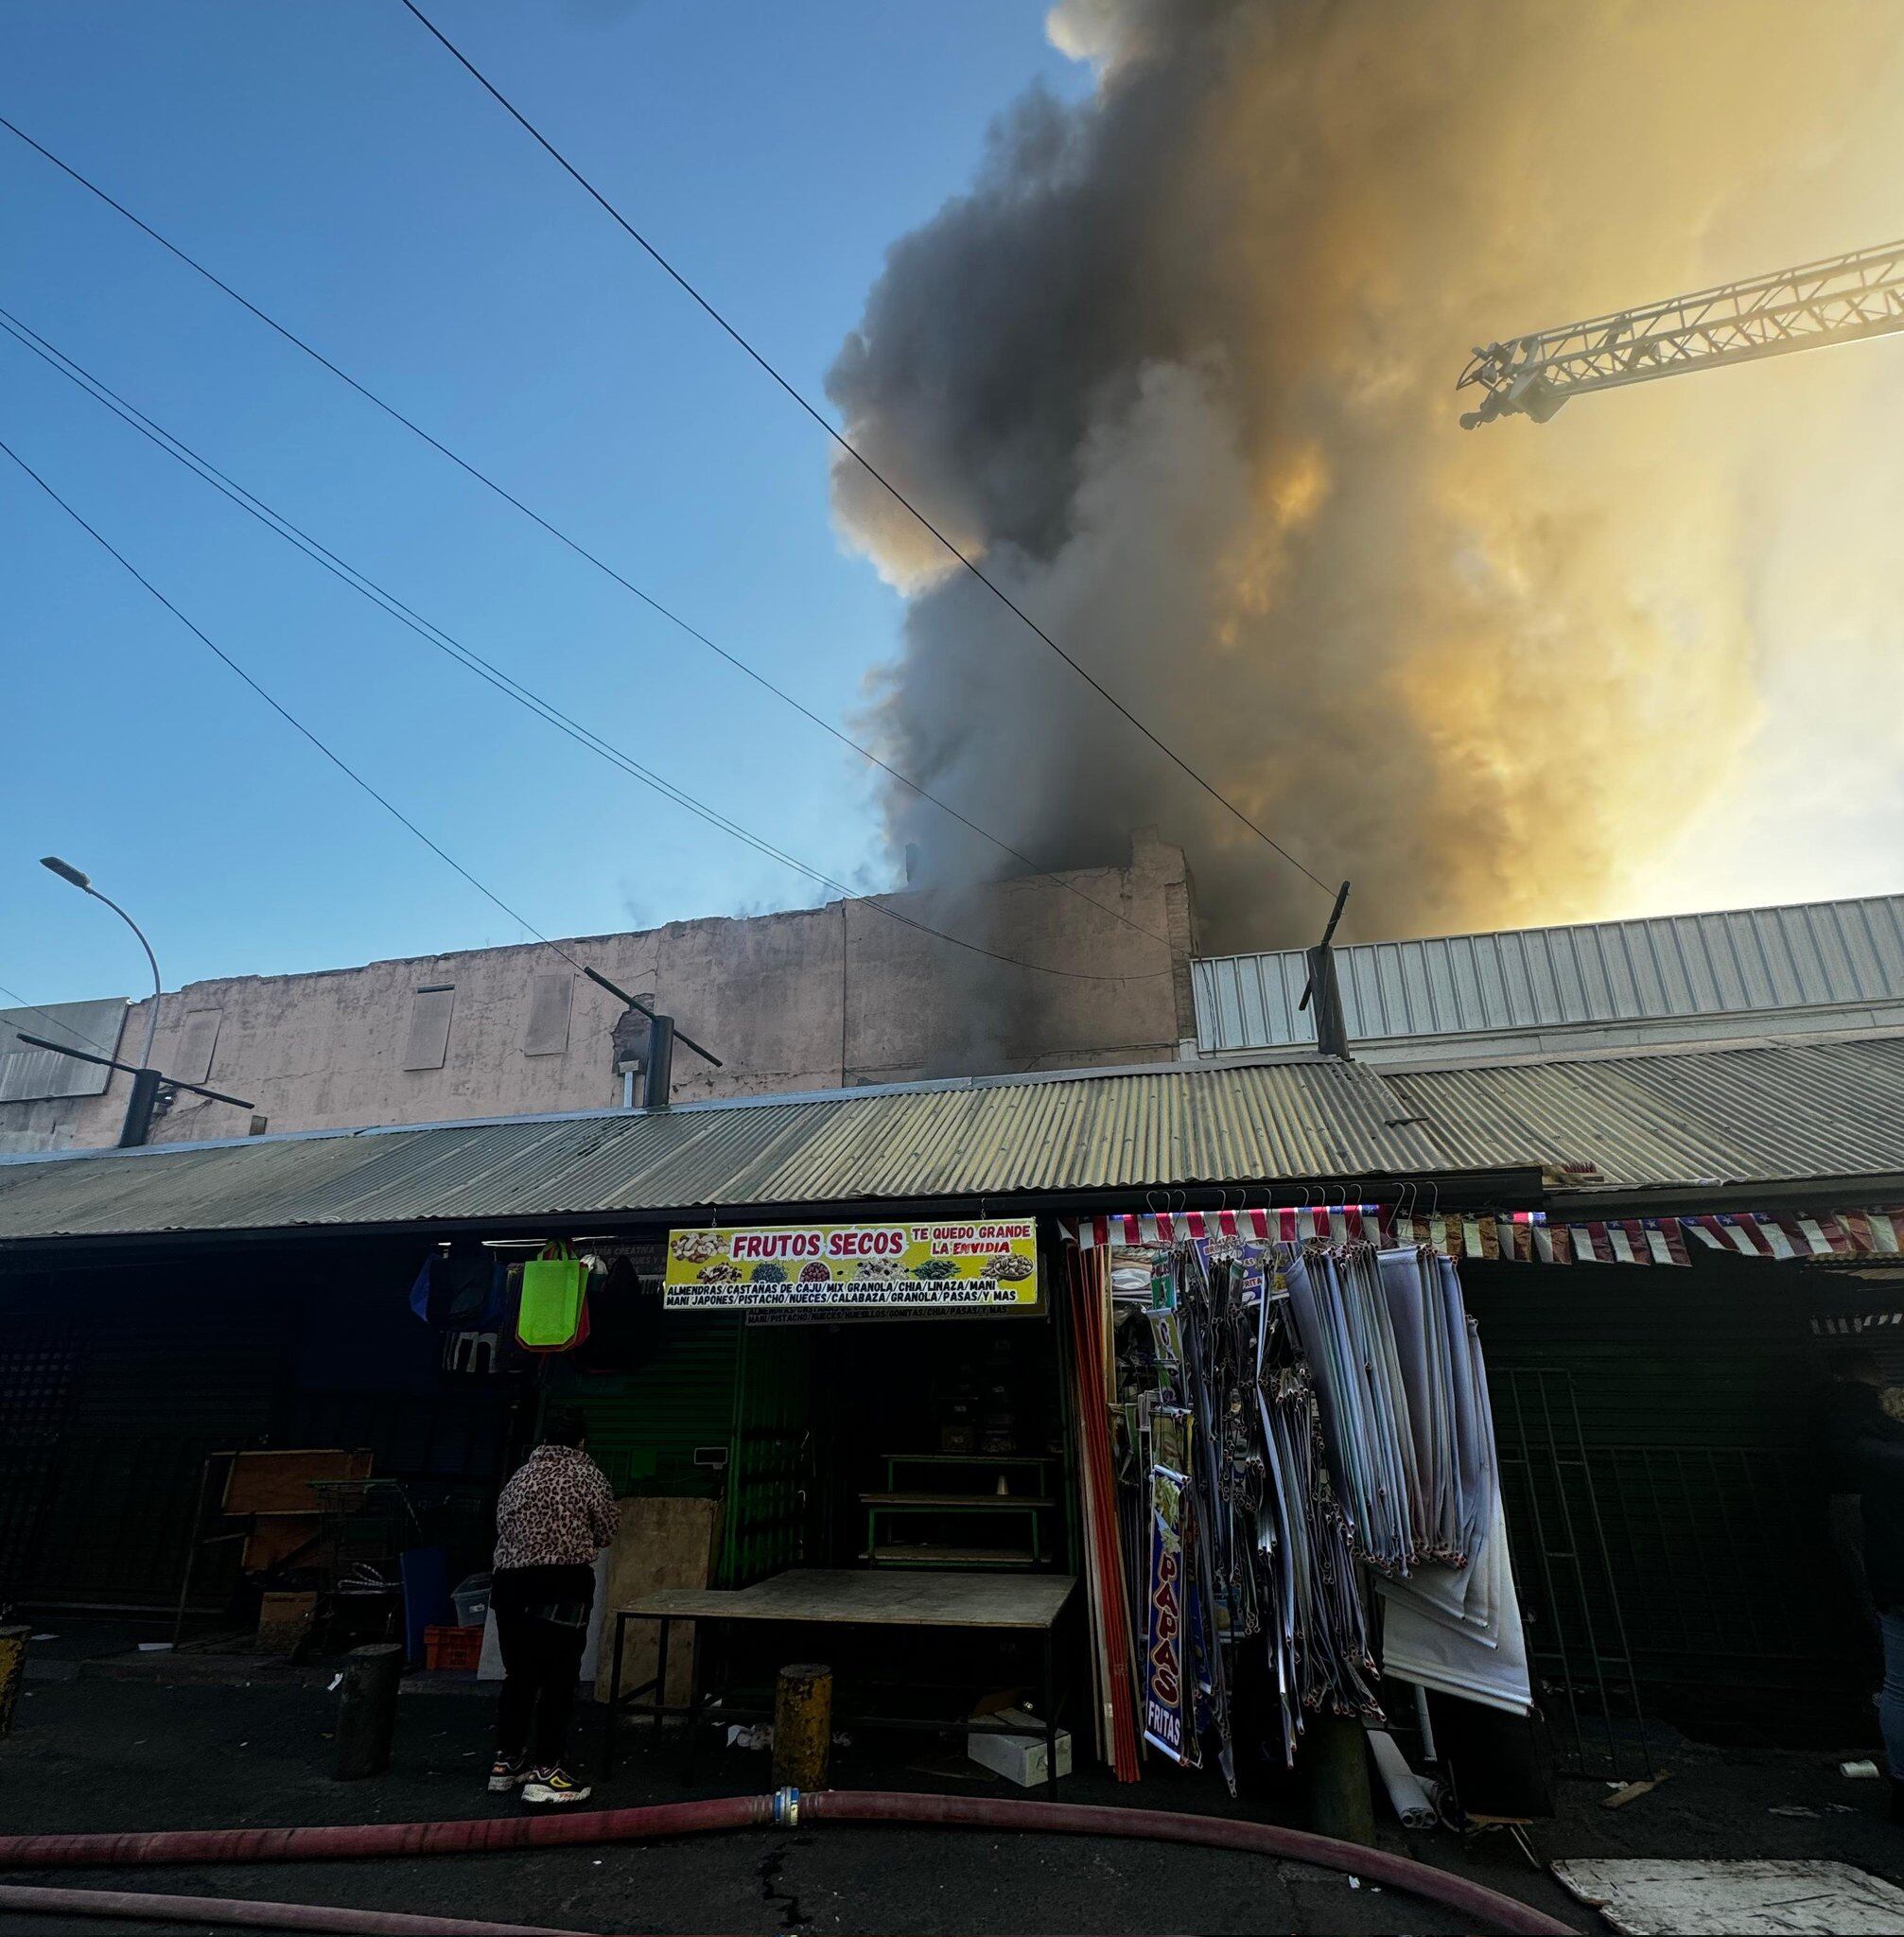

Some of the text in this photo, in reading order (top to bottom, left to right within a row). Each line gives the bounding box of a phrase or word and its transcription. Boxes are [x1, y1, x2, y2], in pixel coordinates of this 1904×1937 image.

[912, 1225, 1031, 1240] TE QUEDO GRANDE
[733, 1231, 903, 1258] FRUTOS SECOS
[932, 1241, 1010, 1255] LA ENVIDIA
[780, 1283, 793, 1293] DE
[666, 1296, 690, 1305] MANI
[993, 1290, 1016, 1301] MAS
[1152, 1553, 1179, 1704] PAPAS
[1147, 1700, 1181, 1747] FRITAS
